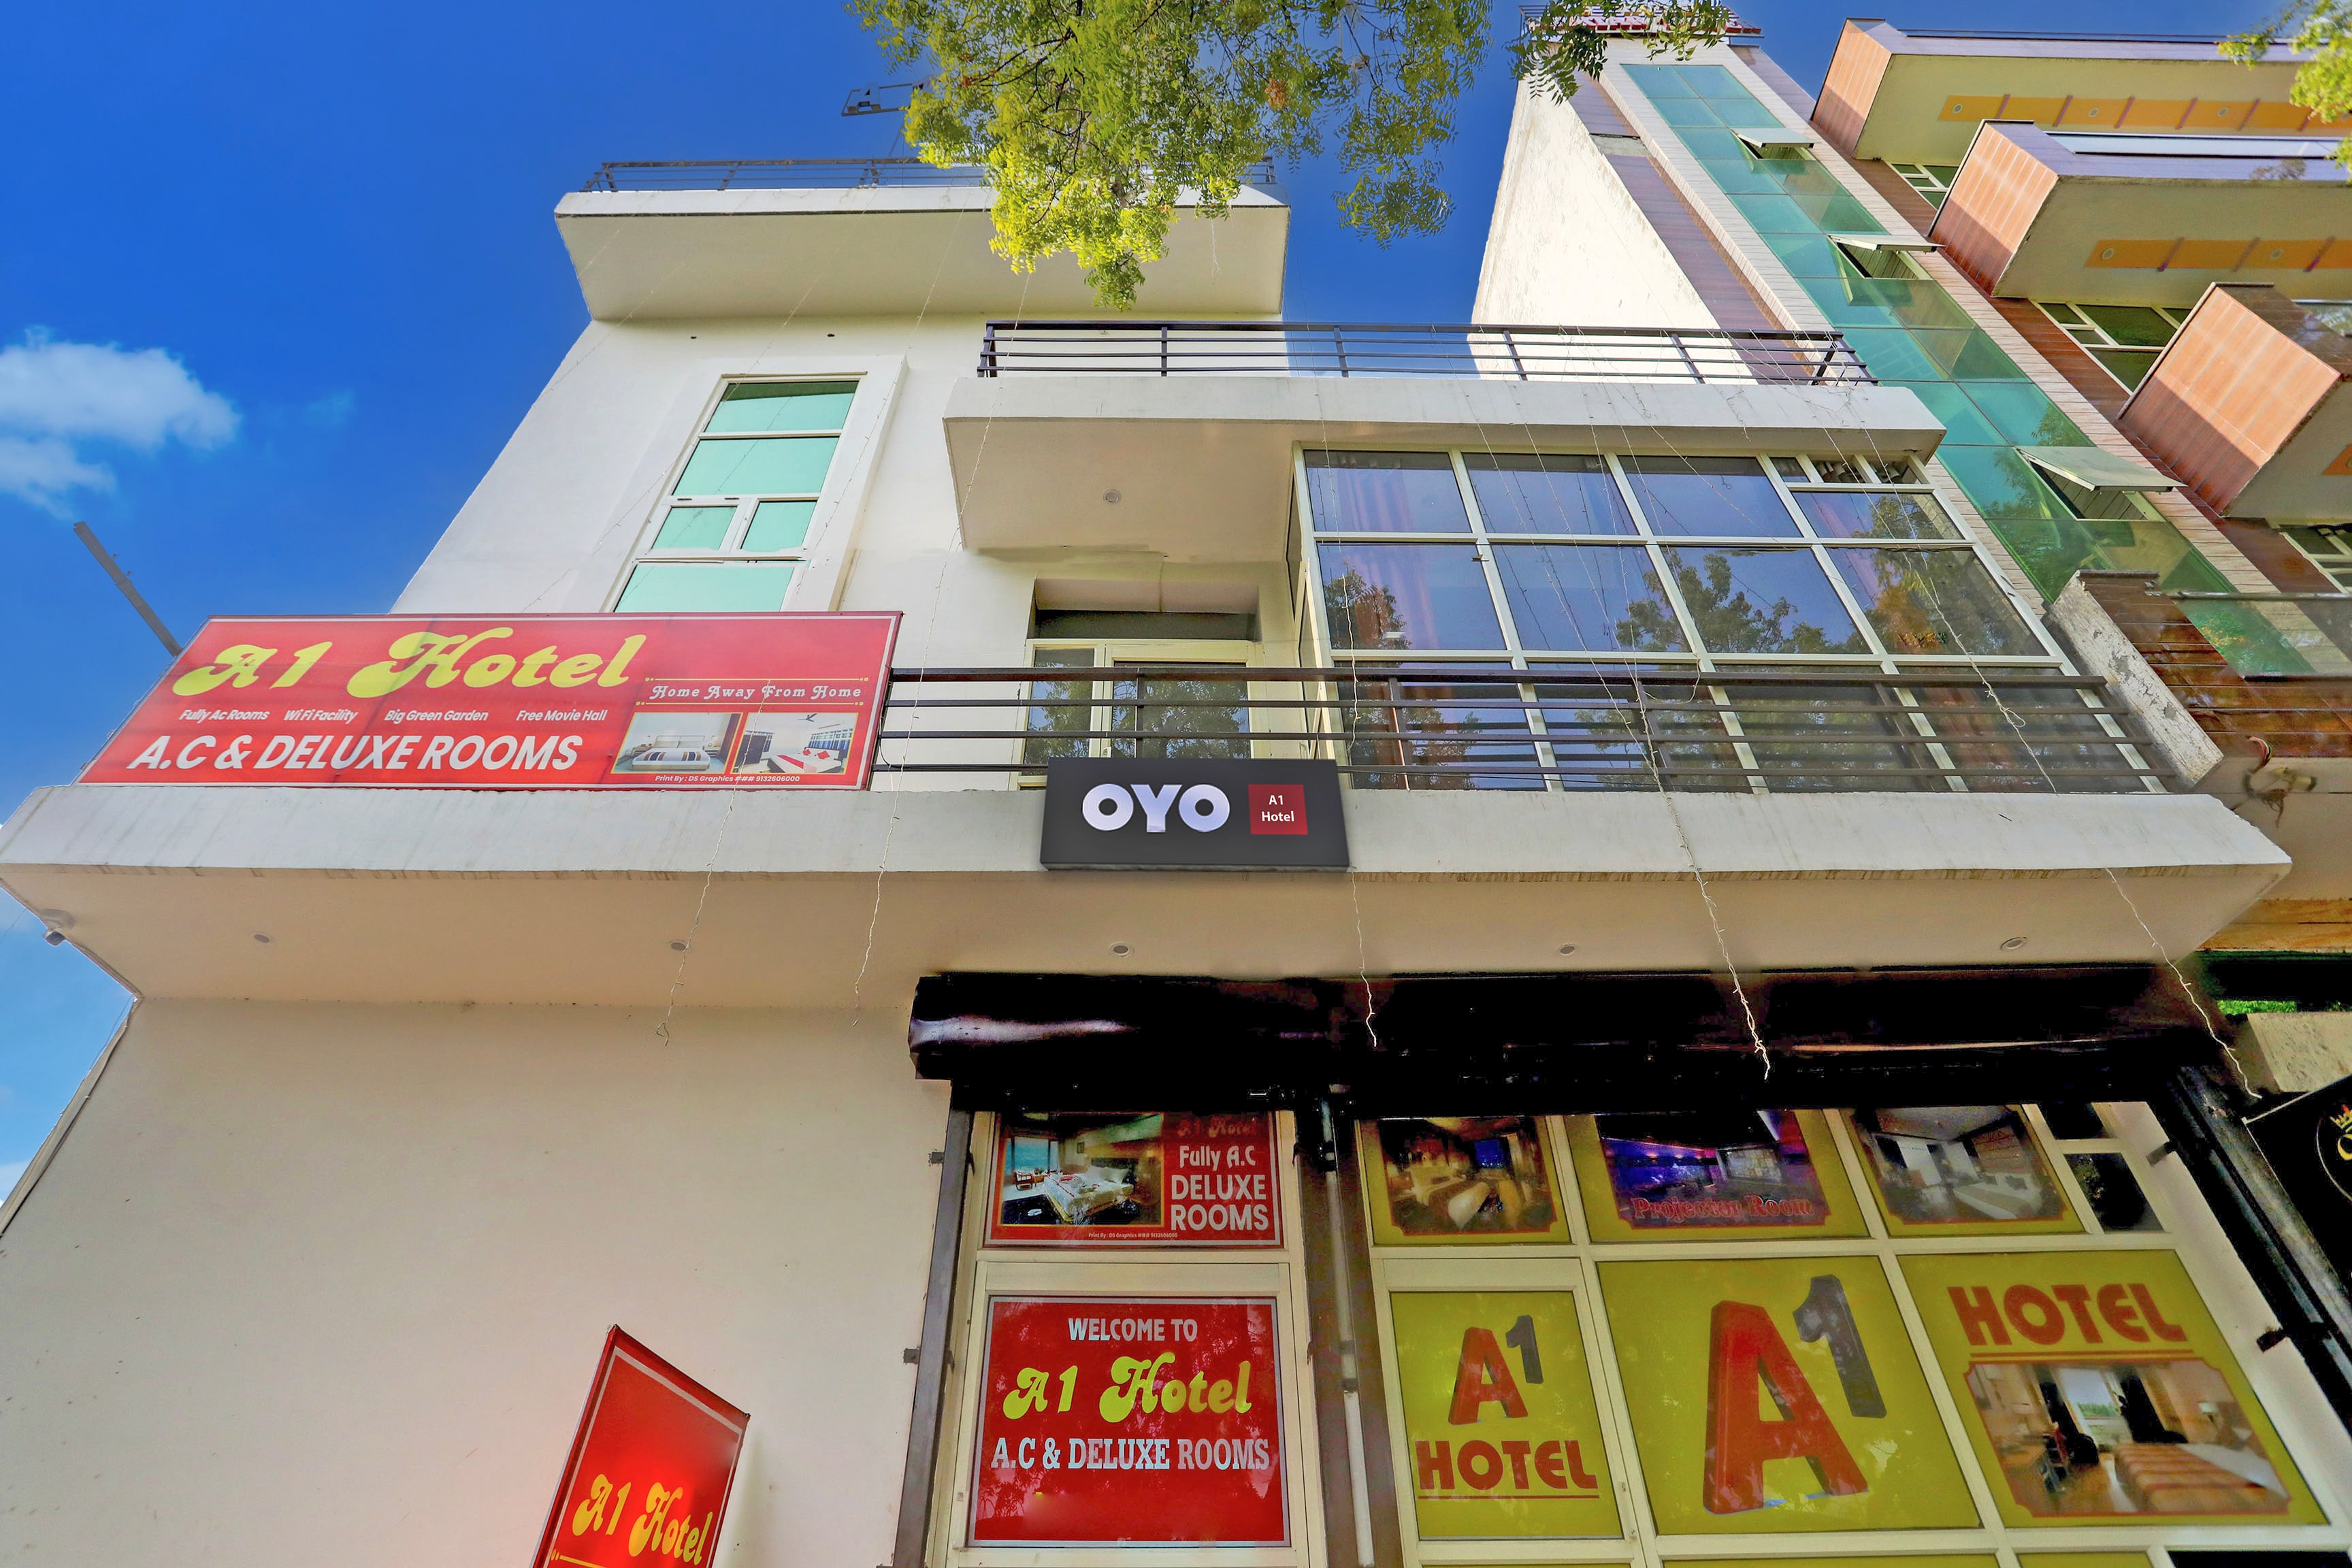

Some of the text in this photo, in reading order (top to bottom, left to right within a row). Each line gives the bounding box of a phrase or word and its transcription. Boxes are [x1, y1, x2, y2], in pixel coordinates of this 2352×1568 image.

[347, 627, 646, 698] Hotel
[649, 685, 862, 700] Home Away From Home
[178, 709, 270, 723] Fully Ac Rooms
[312, 709, 359, 724] Facility
[384, 709, 489, 724] Big Green Garden
[516, 709, 608, 721] Free Movie Hall
[127, 734, 583, 771] A.C & DELUXE ROOMS
[674, 775, 684, 783] By
[700, 775, 734, 783] Graphics
[1082, 783, 1230, 833] OYO
[1269, 795, 1284, 806] A1
[1262, 811, 1294, 823] Hotel
[1179, 1145, 1256, 1171] Fully A.C
[1171, 1175, 1267, 1200] DELUXE
[1171, 1204, 1269, 1231] ROOMS
[1631, 1194, 1815, 1223] Projector Room
[1946, 1284, 2189, 1346] HOTEL
[1068, 1318, 1198, 1342] WELCOME TO
[1448, 1315, 1544, 1425] A1
[1099, 1352, 1252, 1423] Hotel
[1703, 1273, 1887, 1515] A1
[991, 1437, 1271, 1470] A.C & DELUXE ROOMS
[1415, 1439, 1599, 1490] HOTEL
[628, 1482, 713, 1566] Hotel
